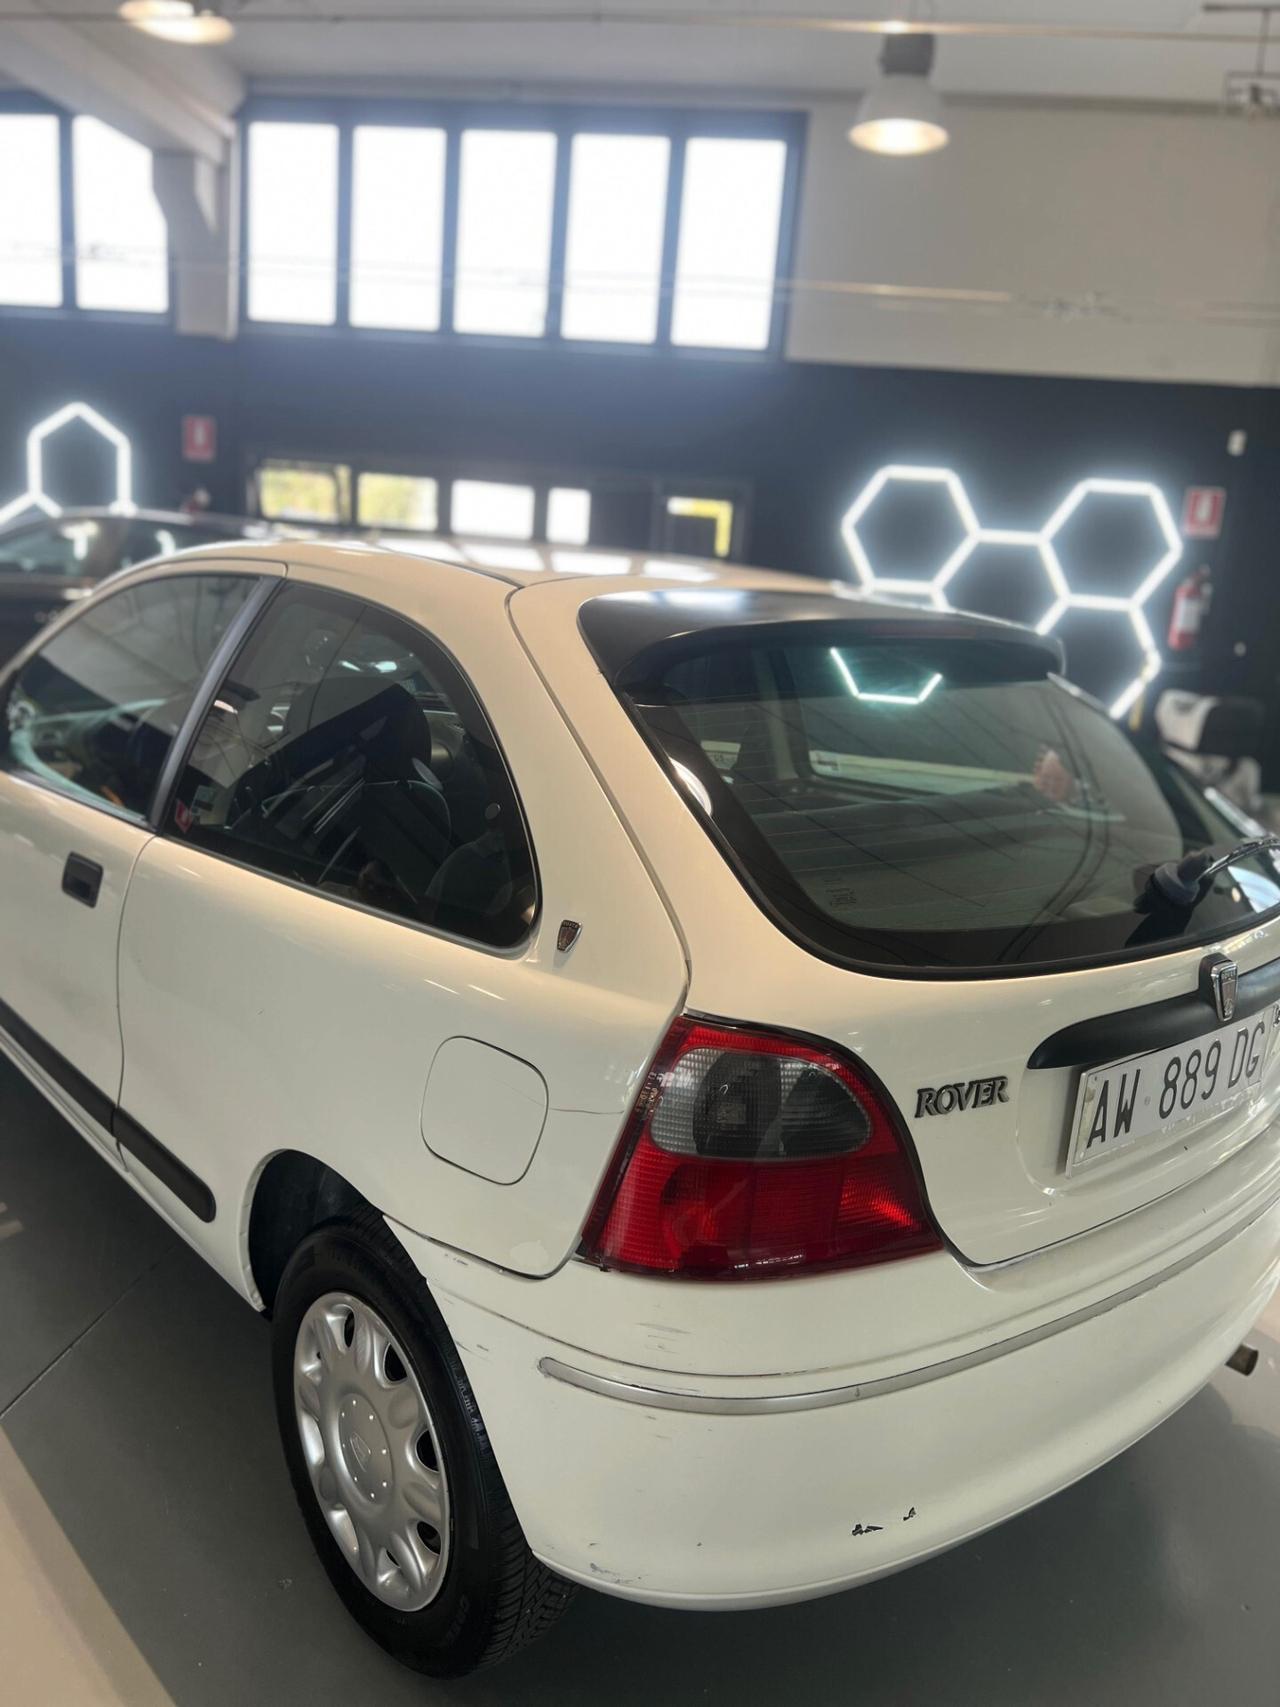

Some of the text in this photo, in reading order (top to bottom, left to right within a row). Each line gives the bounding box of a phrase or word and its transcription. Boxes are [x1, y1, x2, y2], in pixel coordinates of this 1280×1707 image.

[914, 1076, 1010, 1118] ROVER
[1086, 1021, 1265, 1149] AW 889 DG
